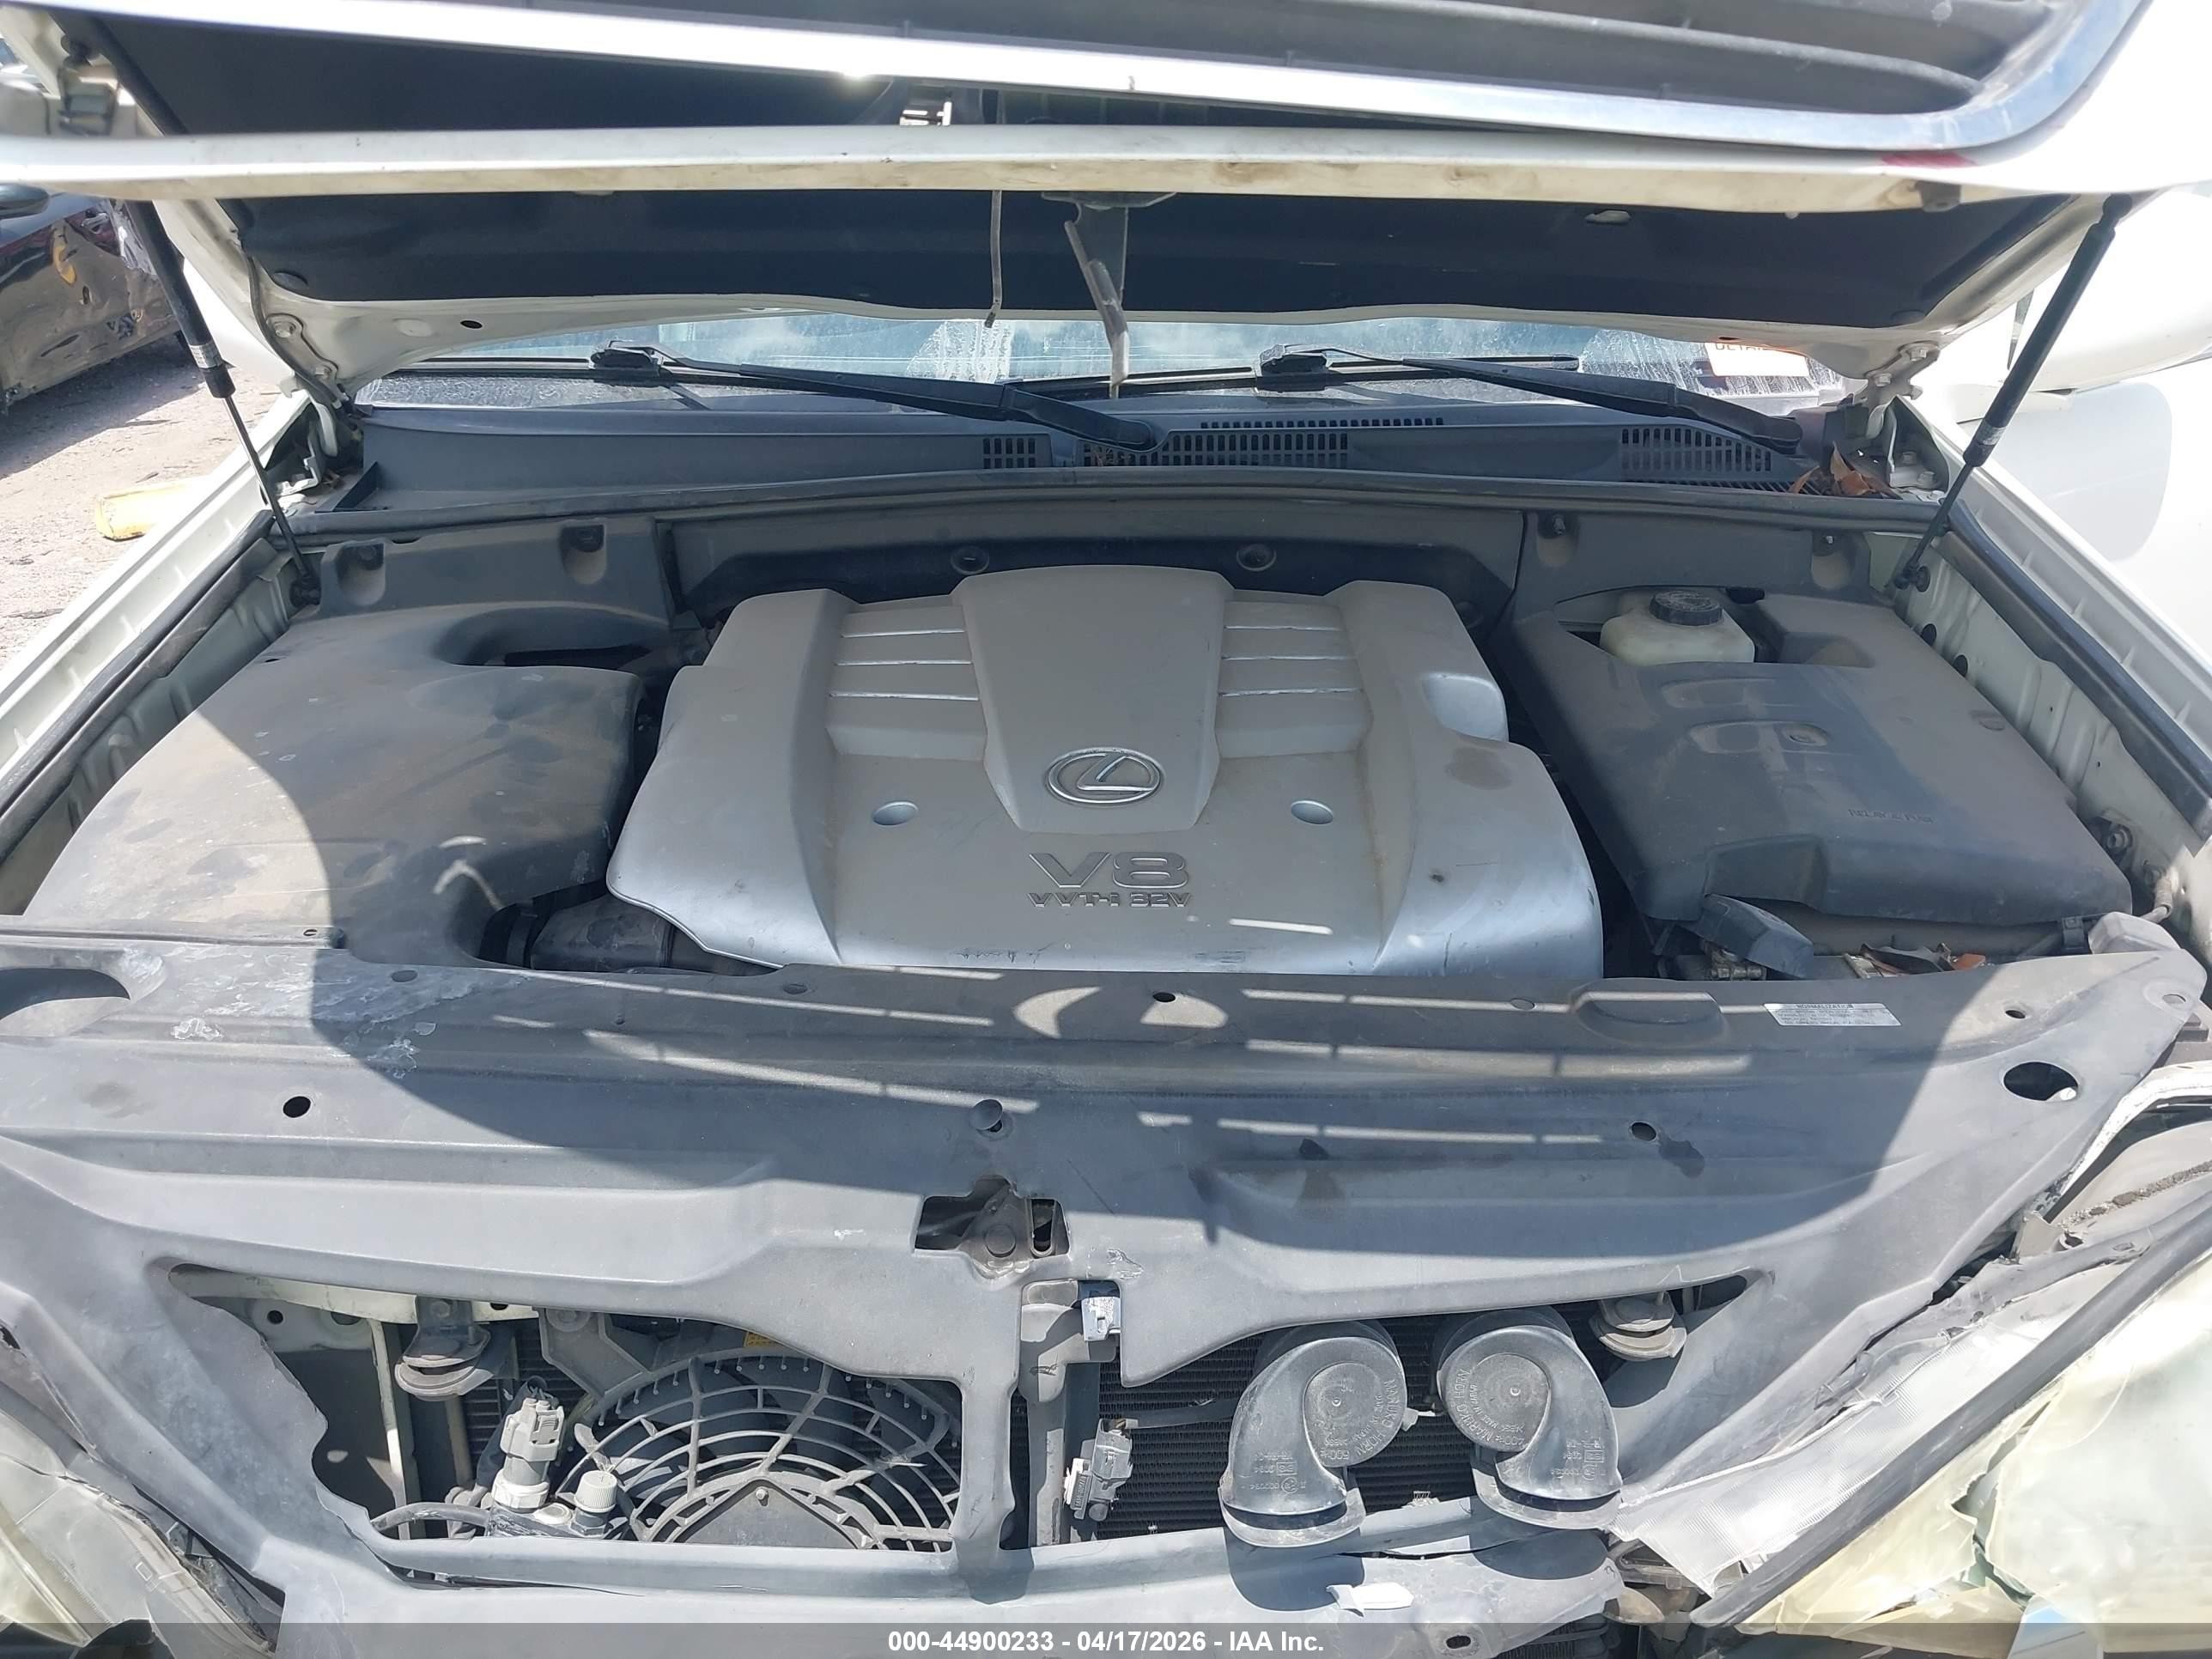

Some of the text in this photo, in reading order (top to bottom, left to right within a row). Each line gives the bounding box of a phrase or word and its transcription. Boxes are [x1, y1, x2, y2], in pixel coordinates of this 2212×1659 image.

[1028, 852, 1189, 889] V8
[1130, 892, 1190, 908] 32V
[1353, 1378, 1401, 1456] MARUKO HORN
[1454, 1368, 1494, 1443] MARUKO HORN
